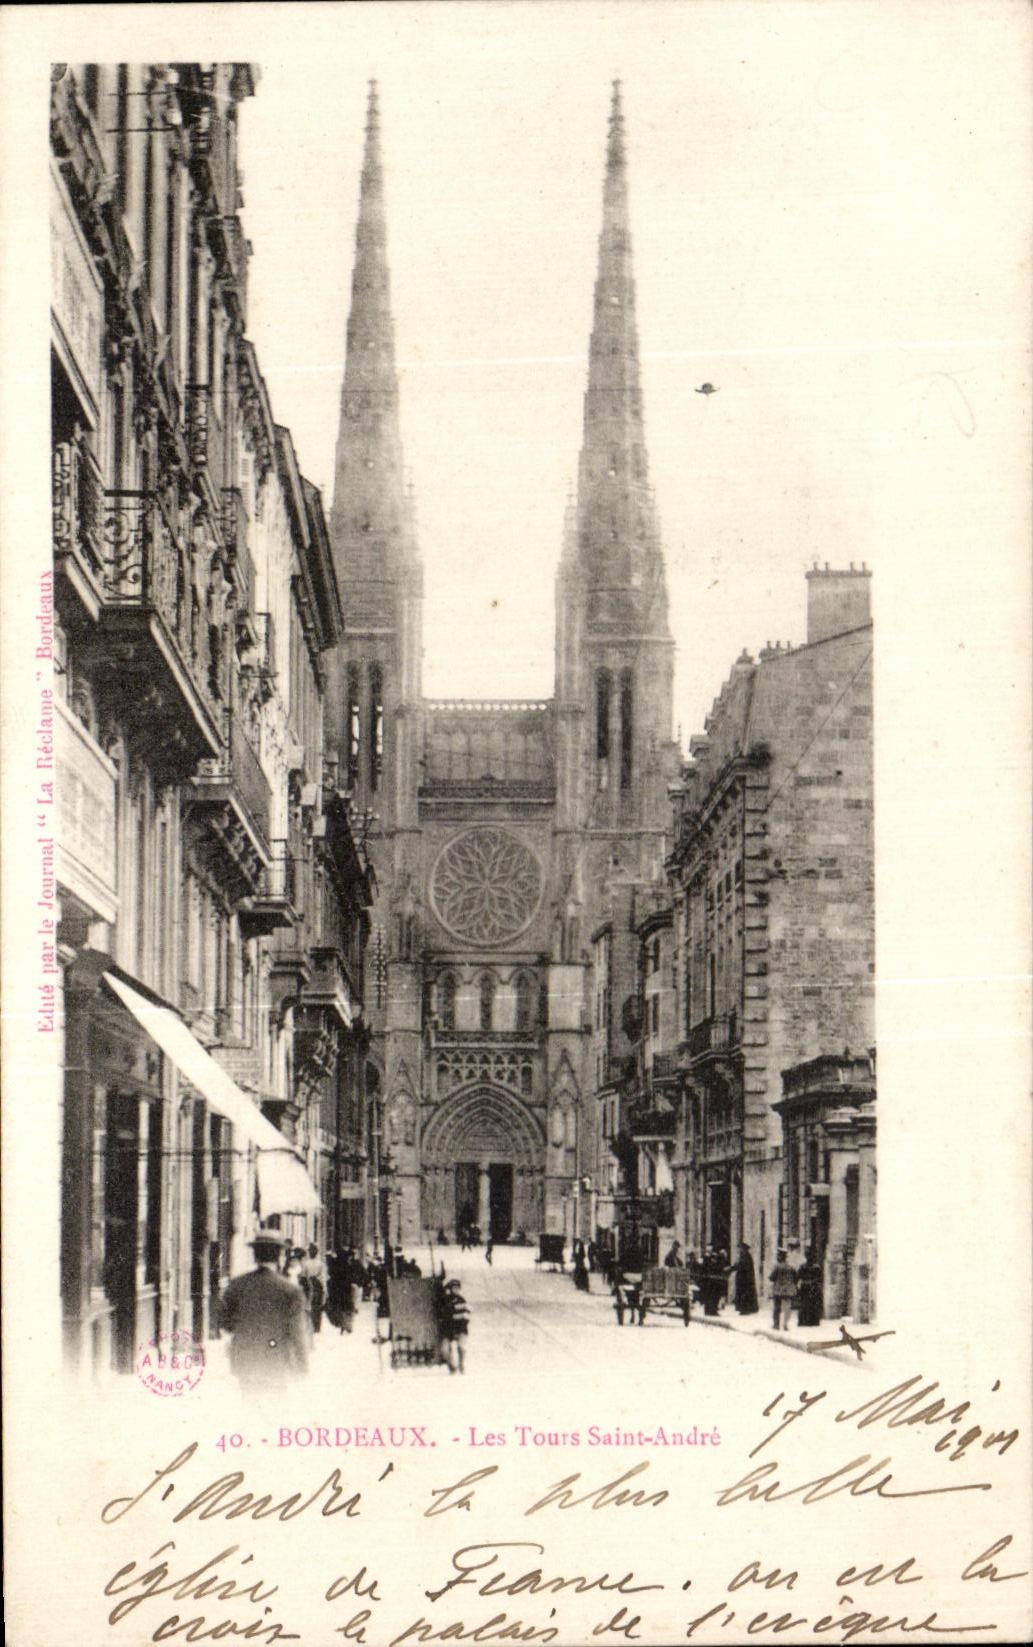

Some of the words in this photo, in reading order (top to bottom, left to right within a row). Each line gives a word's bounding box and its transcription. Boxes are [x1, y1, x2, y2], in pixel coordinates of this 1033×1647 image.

[424, 1465, 500, 1518] la
[524, 1460, 671, 1517] plus
[716, 1454, 993, 1506] belle
[325, 1566, 382, 1602] de
[961, 1534, 1030, 1583] la
[592, 1606, 643, 1641] de
